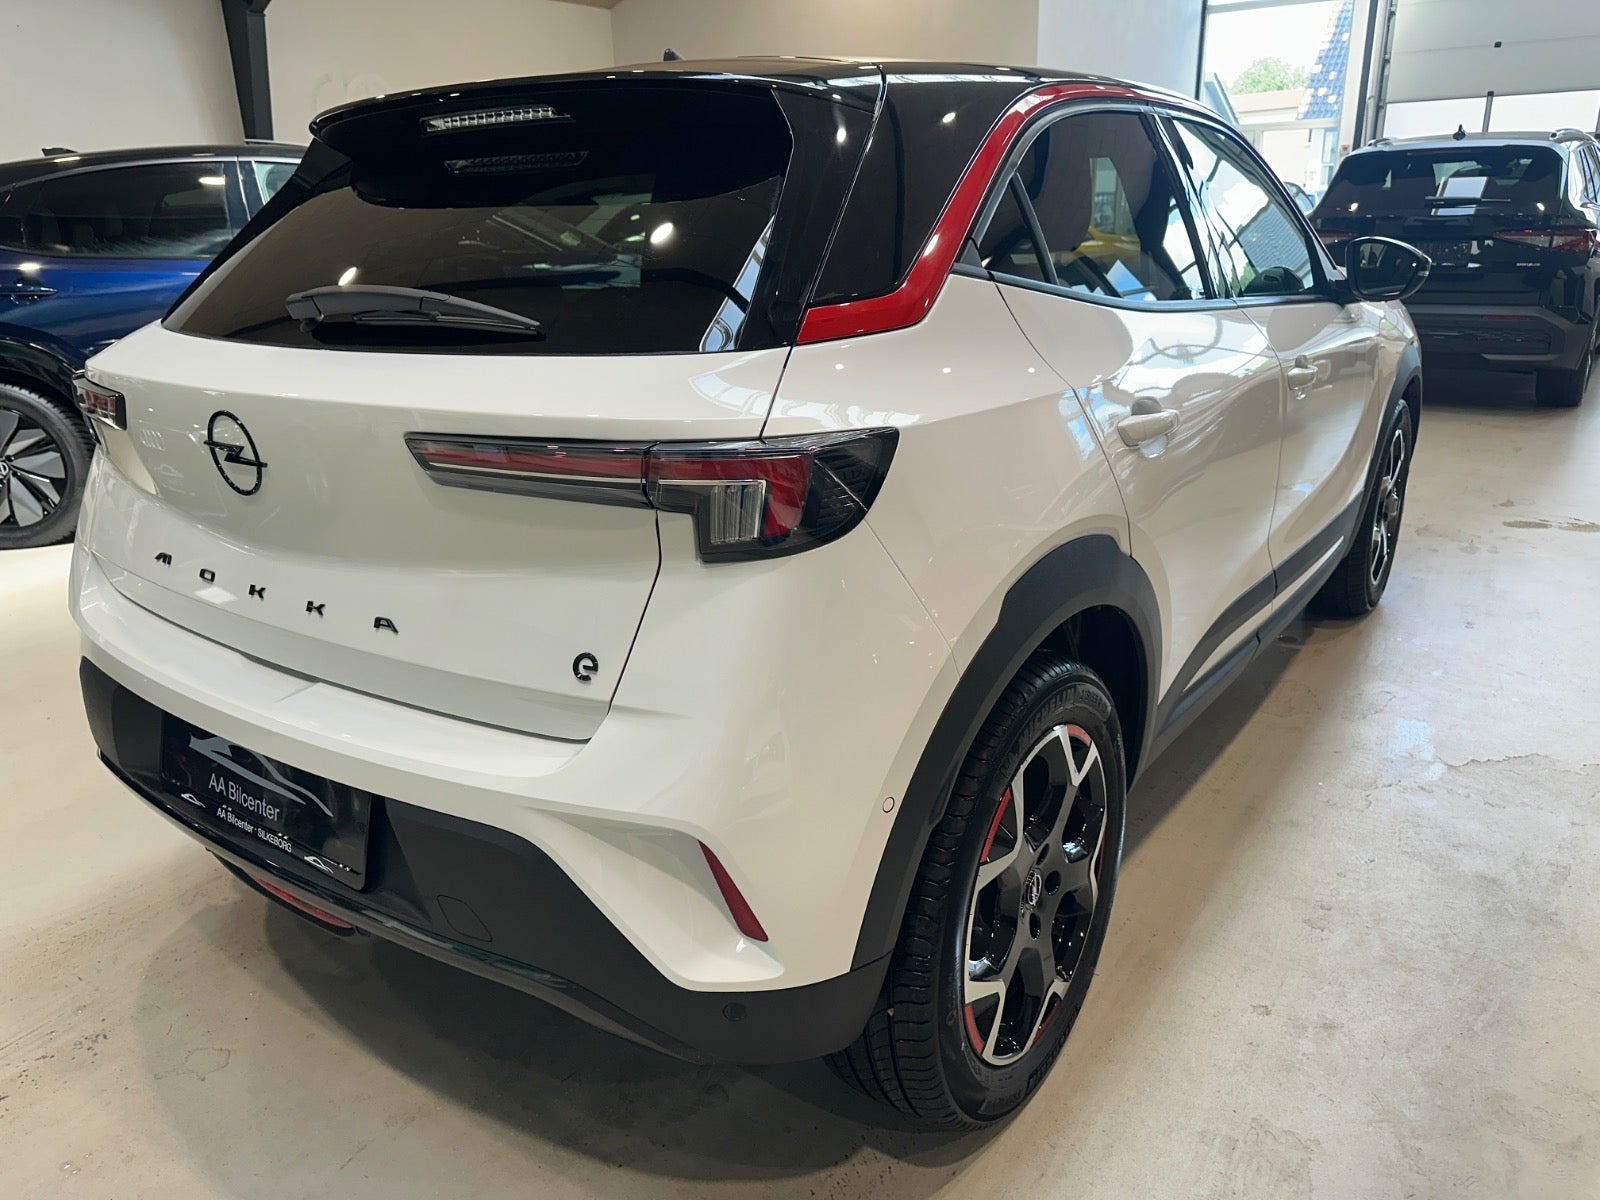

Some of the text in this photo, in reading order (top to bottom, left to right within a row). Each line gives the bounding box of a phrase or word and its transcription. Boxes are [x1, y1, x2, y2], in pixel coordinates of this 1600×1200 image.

[155, 552, 399, 634] MOKKA
[572, 652, 599, 682] e
[208, 773, 280, 821] AA Bilcenter
[216, 807, 292, 852] AA Bilcenter SILKEBORG
